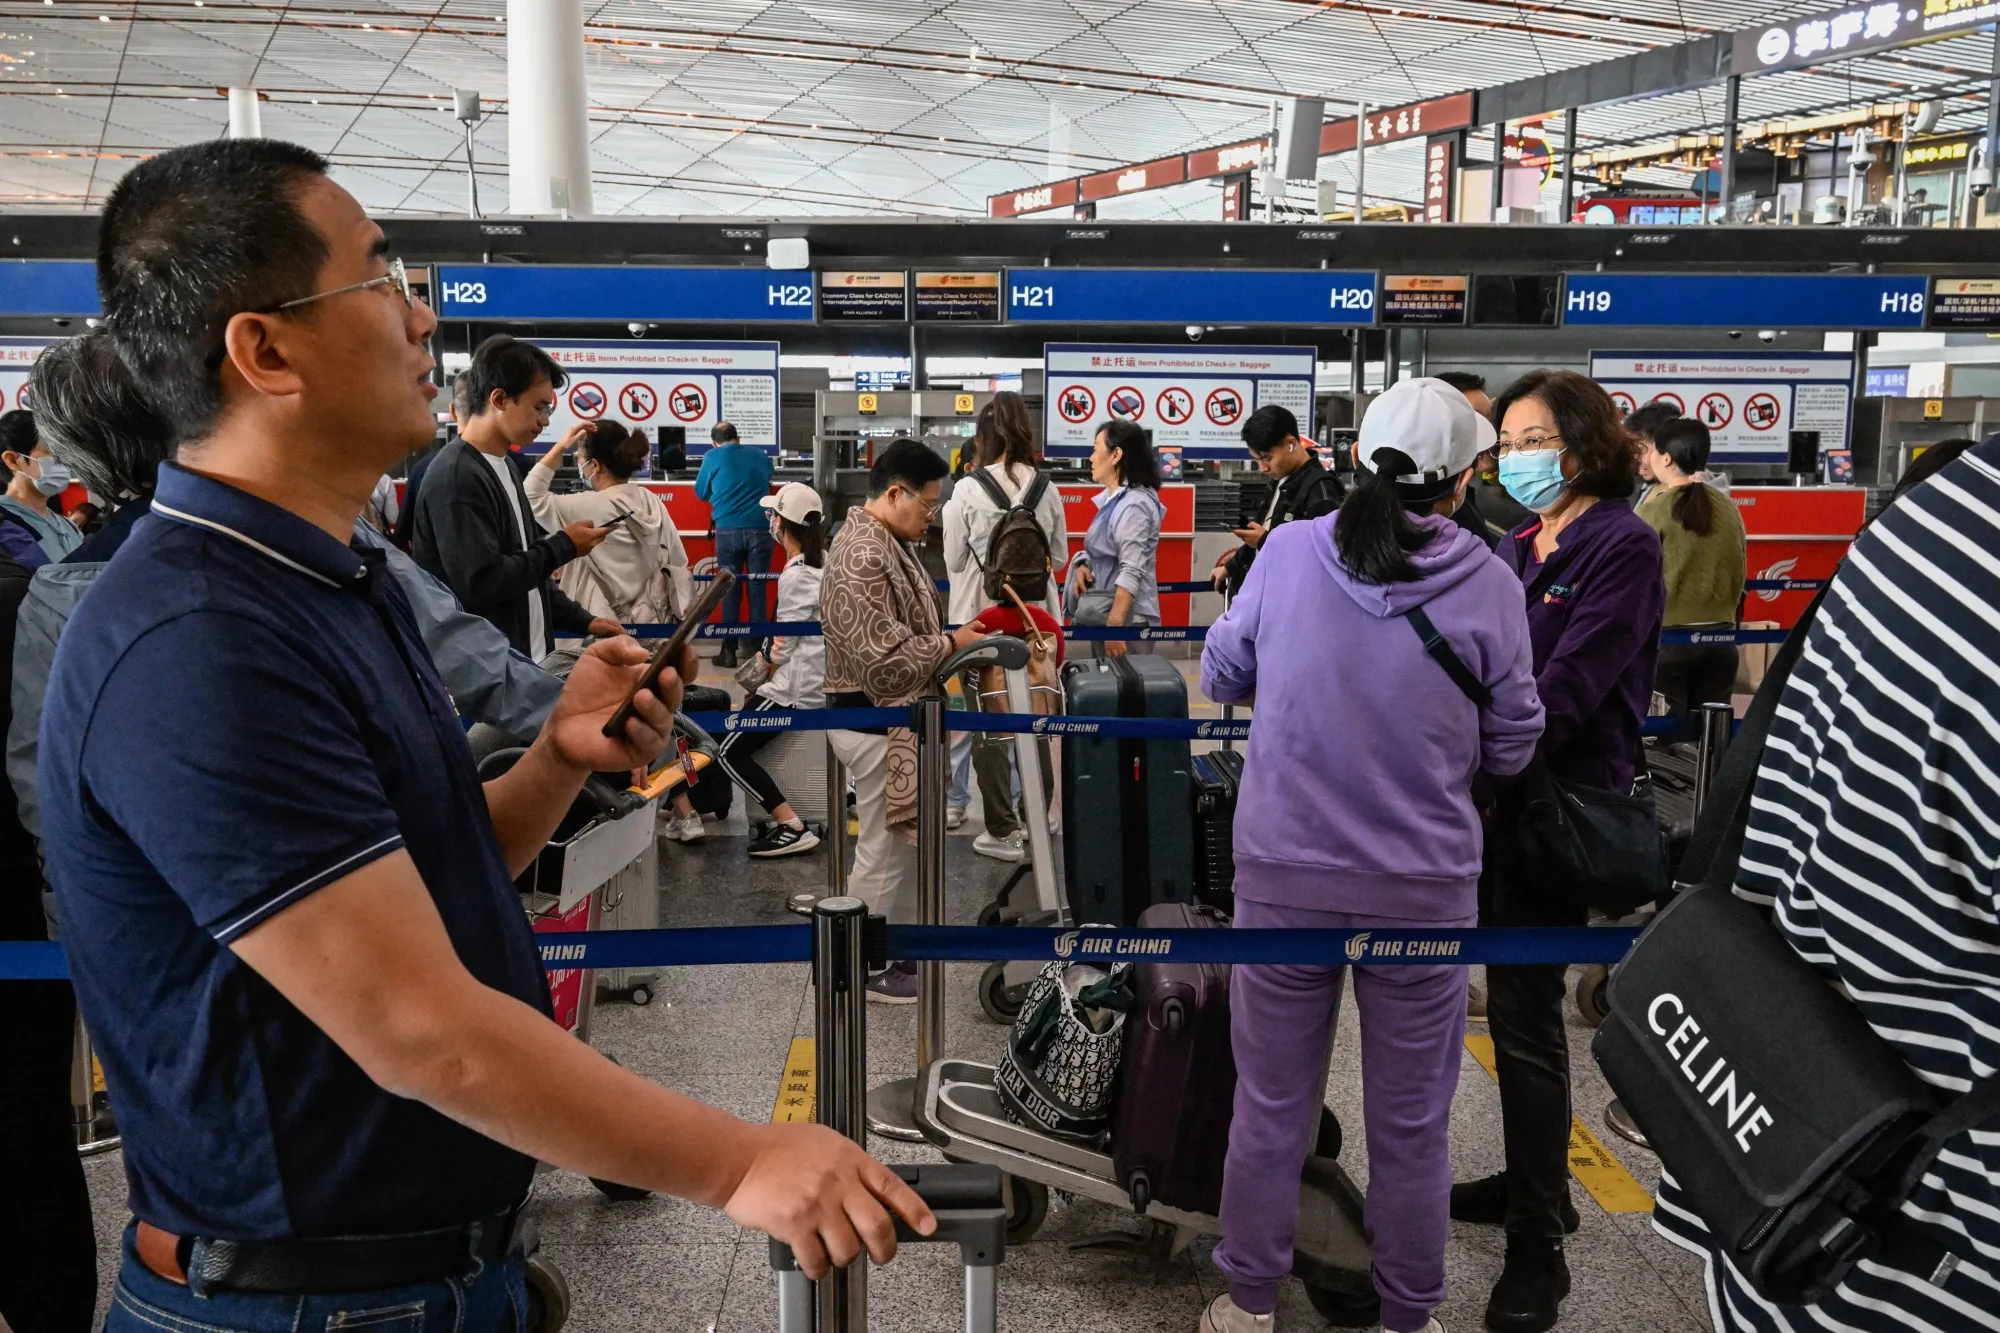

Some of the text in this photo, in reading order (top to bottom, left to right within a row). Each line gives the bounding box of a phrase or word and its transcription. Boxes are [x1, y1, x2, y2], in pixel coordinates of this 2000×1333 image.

[443, 282, 486, 303] H23
[768, 285, 812, 306] H22
[1012, 286, 1053, 306] H21
[1331, 288, 1373, 309] H20
[1568, 290, 1611, 311] H19
[1881, 292, 1923, 313] H18
[551, 352, 596, 362] 禁止托运
[1092, 357, 1136, 367] 禁止托运
[1634, 363, 1677, 373] 禁止托运
[740, 717, 792, 727] AIR CHINA
[1048, 723, 1099, 732] AIR CHINA
[1212, 727, 1250, 736] AIR CHI
[538, 944, 586, 960] HINA
[1081, 938, 1172, 954] AIR CHINA
[1372, 941, 1461, 956] AIR CHINA
[1647, 992, 1774, 1154] CELINE
[1025, 1093, 1061, 1129] DIOR
[1589, 1145, 1616, 1168] Please
